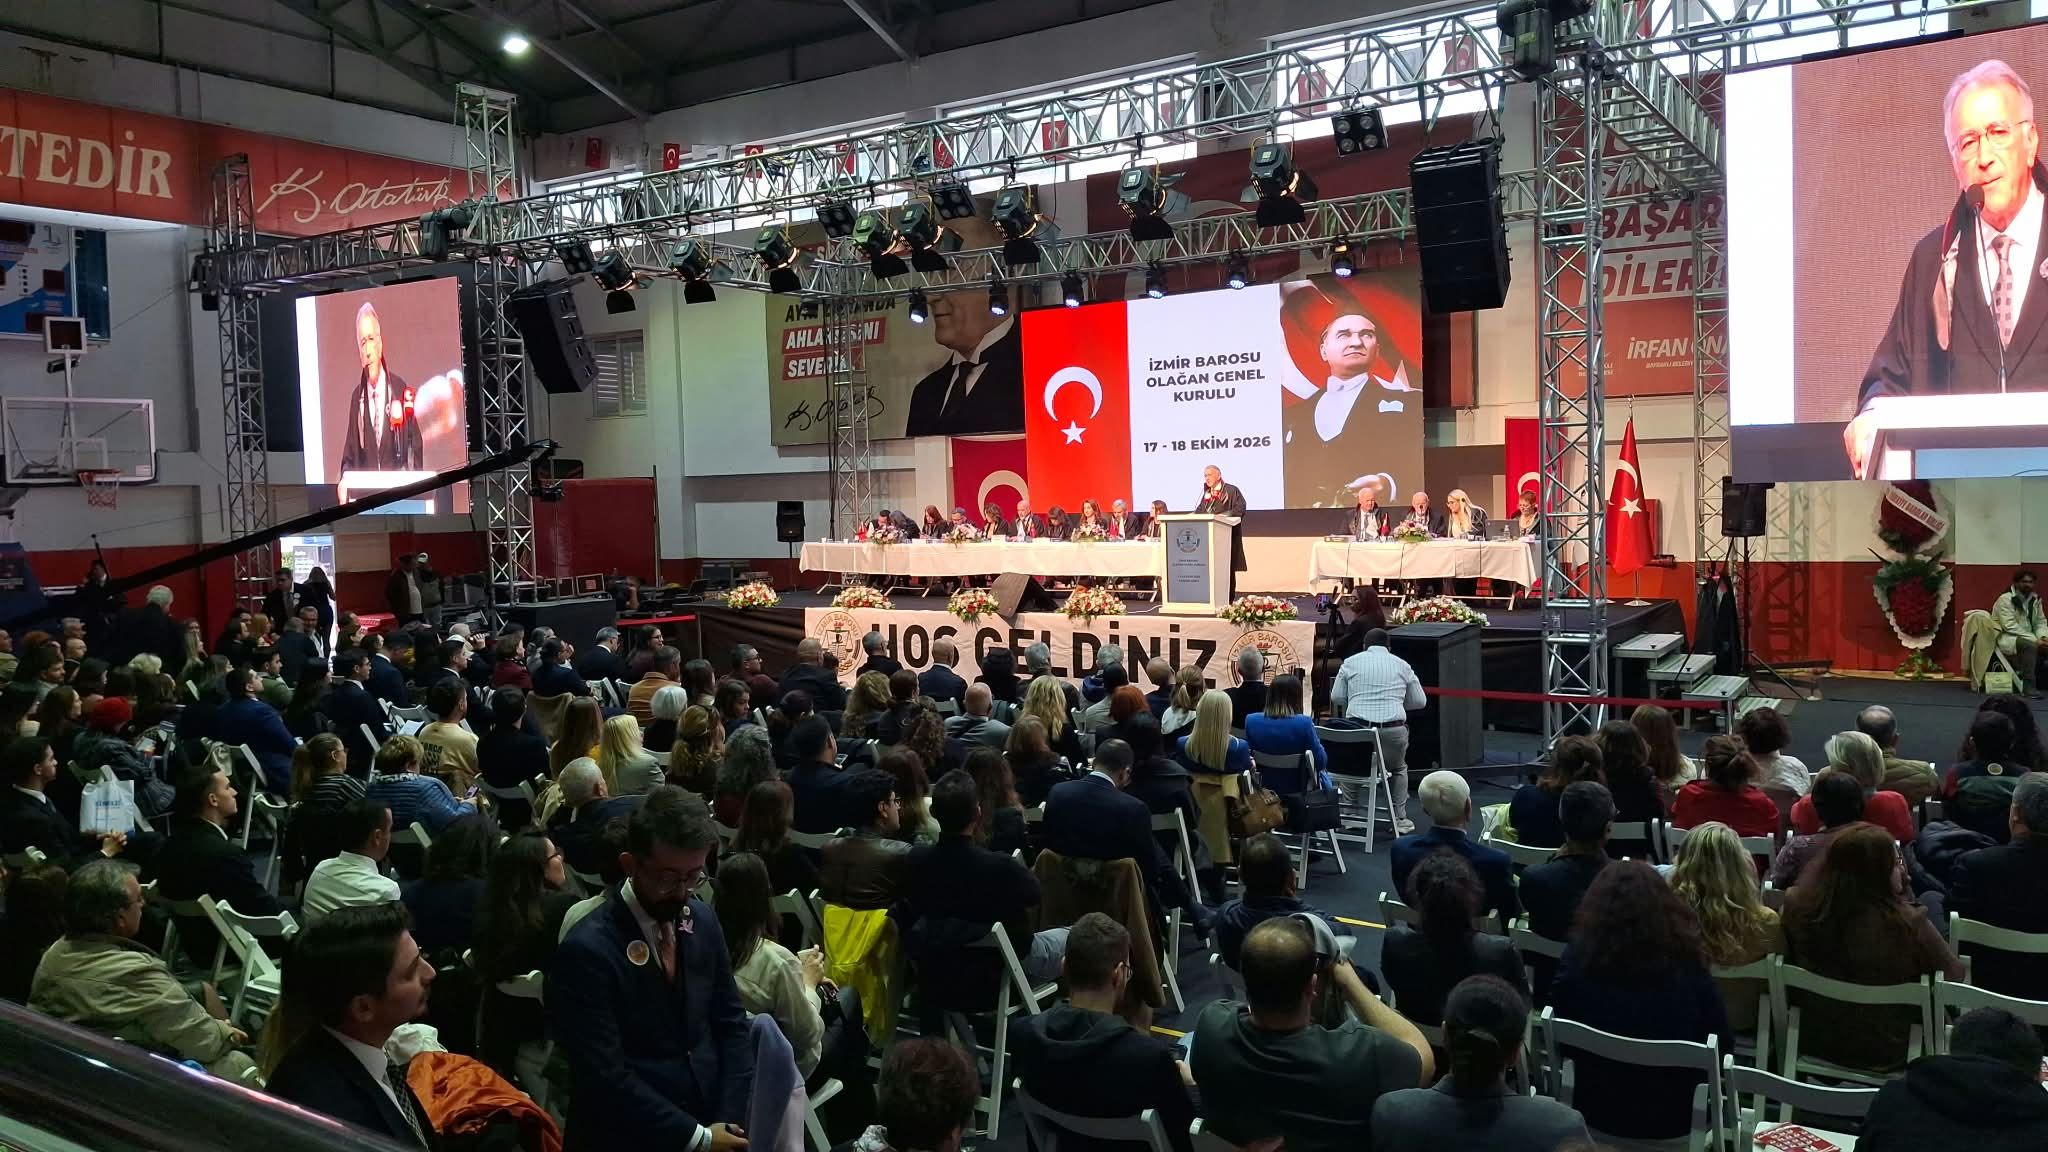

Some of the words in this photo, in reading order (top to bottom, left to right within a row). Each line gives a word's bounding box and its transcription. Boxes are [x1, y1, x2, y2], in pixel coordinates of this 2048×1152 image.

[1627, 337, 1688, 360] İRFAN
[1149, 355, 1191, 371] İZMİR
[1195, 351, 1261, 367] BAROSU
[1146, 372, 1209, 388] OLAĞAN
[1214, 369, 1265, 383] GENEL
[1173, 387, 1236, 402] KURULU
[1144, 442, 1158, 453] 17
[1171, 440, 1186, 451] 18
[1191, 436, 1229, 451] EKİM
[1233, 436, 1271, 449] 2026
